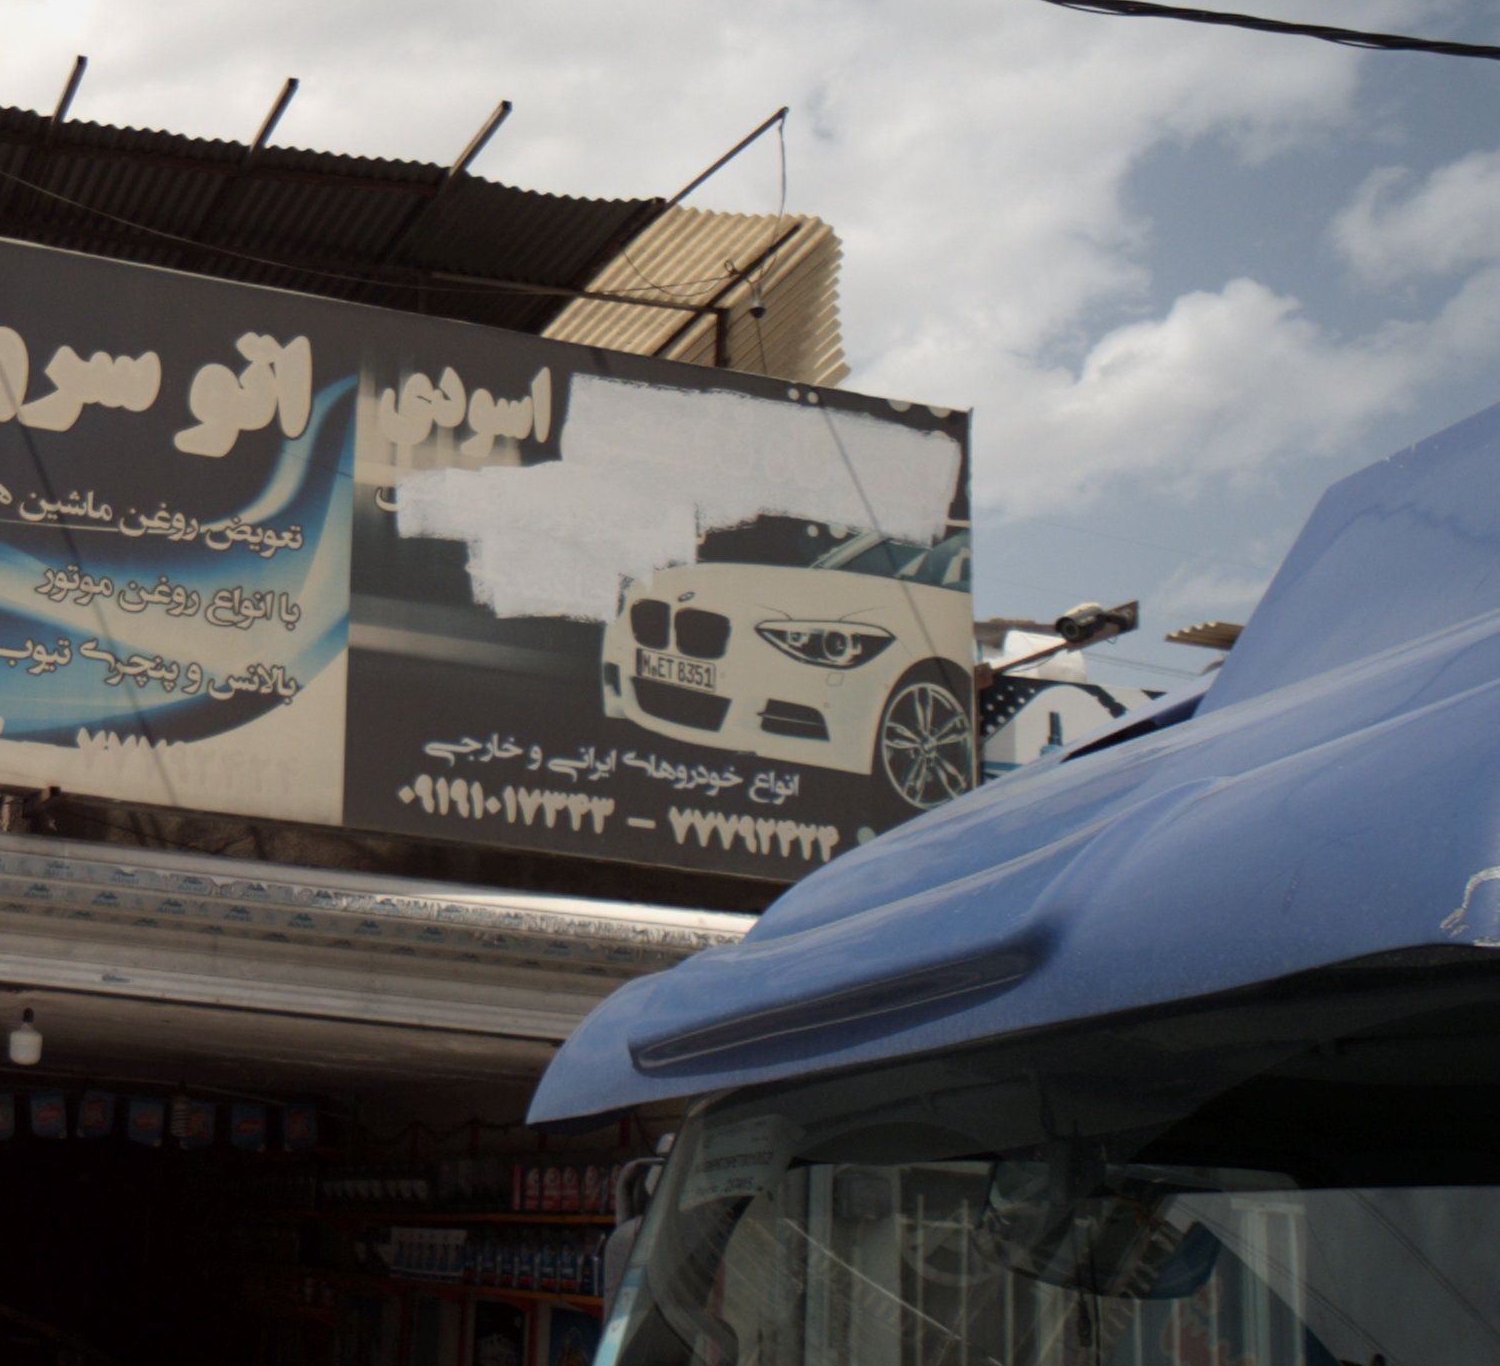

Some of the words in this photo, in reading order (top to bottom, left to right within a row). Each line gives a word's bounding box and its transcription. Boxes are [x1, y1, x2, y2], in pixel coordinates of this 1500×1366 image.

[174, 332, 312, 458] اتو
[19, 489, 113, 522] ماشین
[118, 501, 199, 542] روغن
[205, 514, 304, 558] تعویض
[34, 564, 115, 606] موتور
[117, 574, 201, 617] روغن
[204, 585, 275, 630] انواع
[278, 591, 301, 631] با
[180, 660, 204, 694] و
[207, 661, 300, 704] بالانس
[423, 733, 524, 768] خارجی
[527, 745, 543, 770] و
[548, 747, 617, 783] ایرانی
[750, 771, 800, 805] انواع
